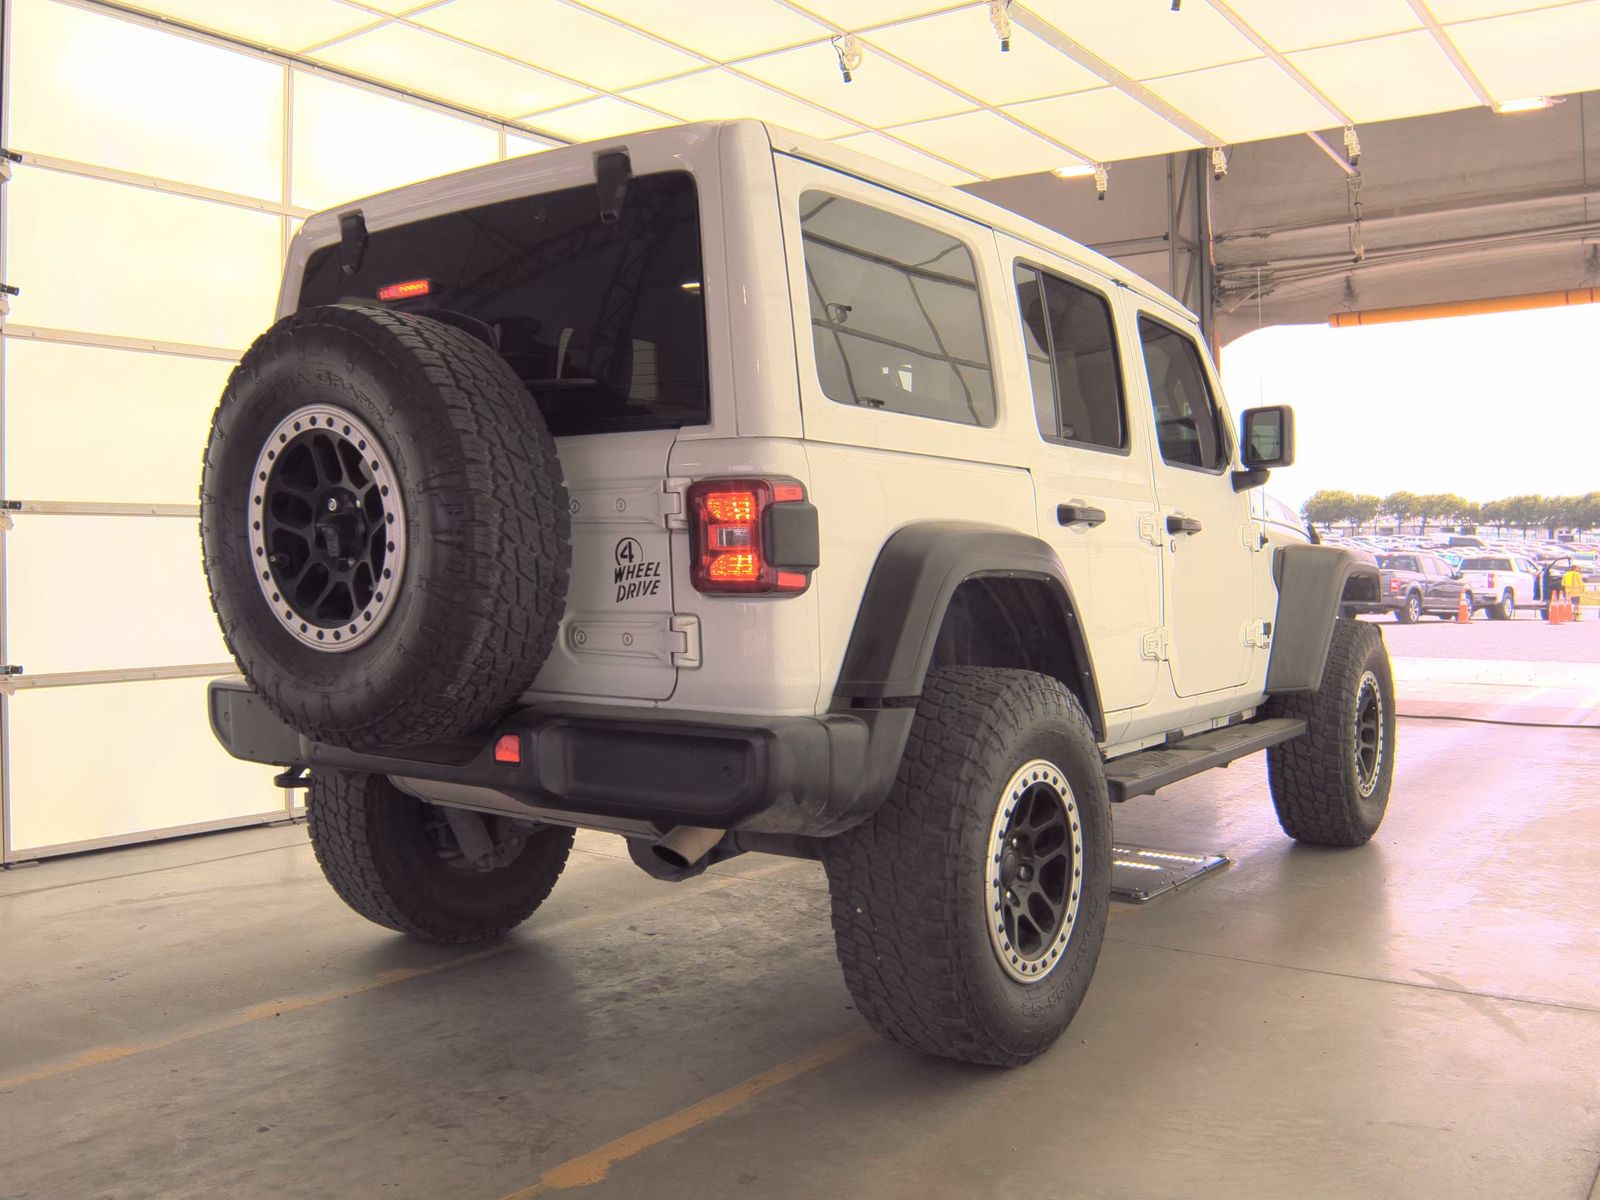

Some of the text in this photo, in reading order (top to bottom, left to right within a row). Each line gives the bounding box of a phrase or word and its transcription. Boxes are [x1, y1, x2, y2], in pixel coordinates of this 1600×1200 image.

[620, 541, 634, 563] 4
[614, 562, 661, 584] WHEEL
[616, 580, 661, 603] DRIVE
